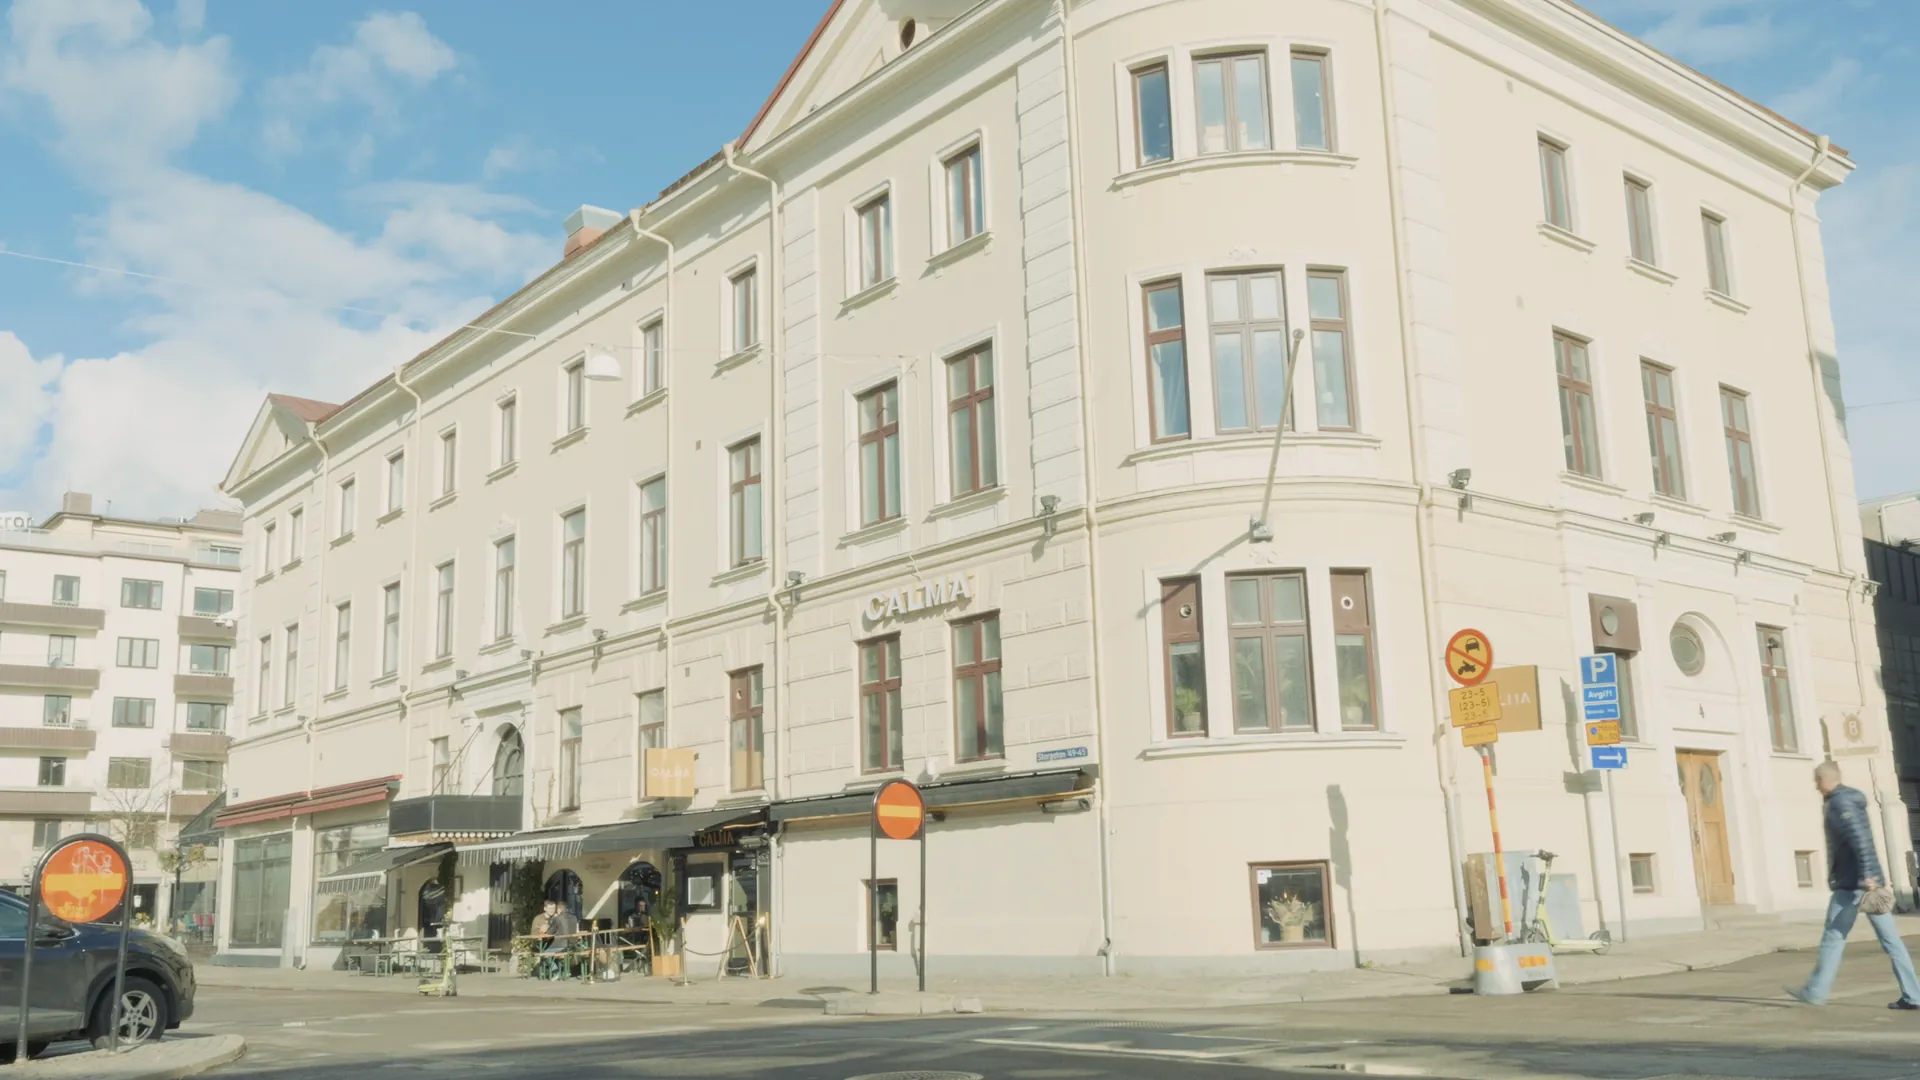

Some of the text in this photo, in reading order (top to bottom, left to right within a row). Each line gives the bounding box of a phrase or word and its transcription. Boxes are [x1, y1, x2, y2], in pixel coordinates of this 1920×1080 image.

[864, 571, 971, 622] CALMA
[1590, 657, 1608, 683] P
[1461, 687, 1486, 700] 23-5
[1587, 689, 1612, 700] Avgift
[1458, 697, 1491, 712] (23-5)
[699, 831, 735, 848] CALMA
